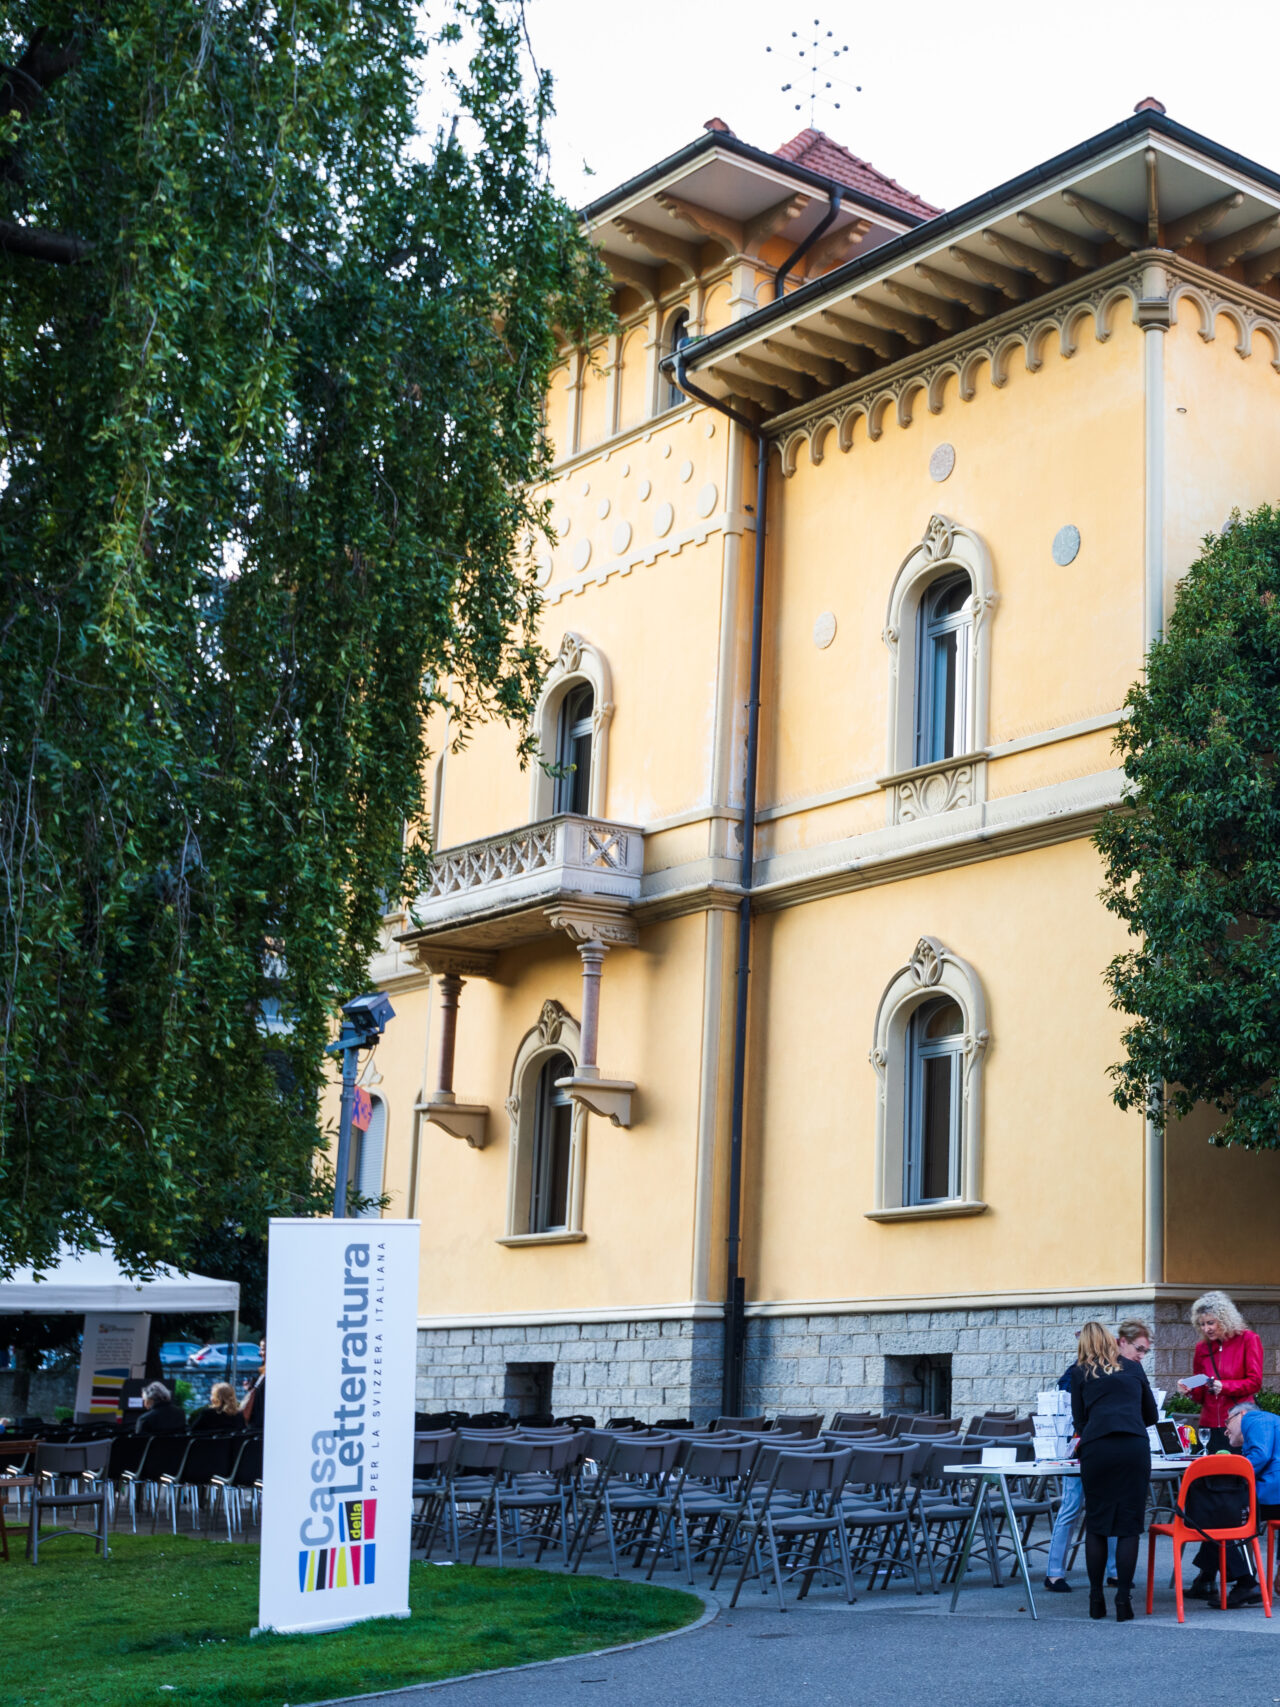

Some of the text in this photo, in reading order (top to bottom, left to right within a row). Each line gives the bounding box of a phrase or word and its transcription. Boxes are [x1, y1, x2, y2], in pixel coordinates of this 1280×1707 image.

[329, 1243, 370, 1494] Letteratura
[370, 1242, 386, 1492] PER LA SVIZZERA ITALIANA
[300, 1430, 337, 1546] Casa
[350, 1503, 362, 1539] della
